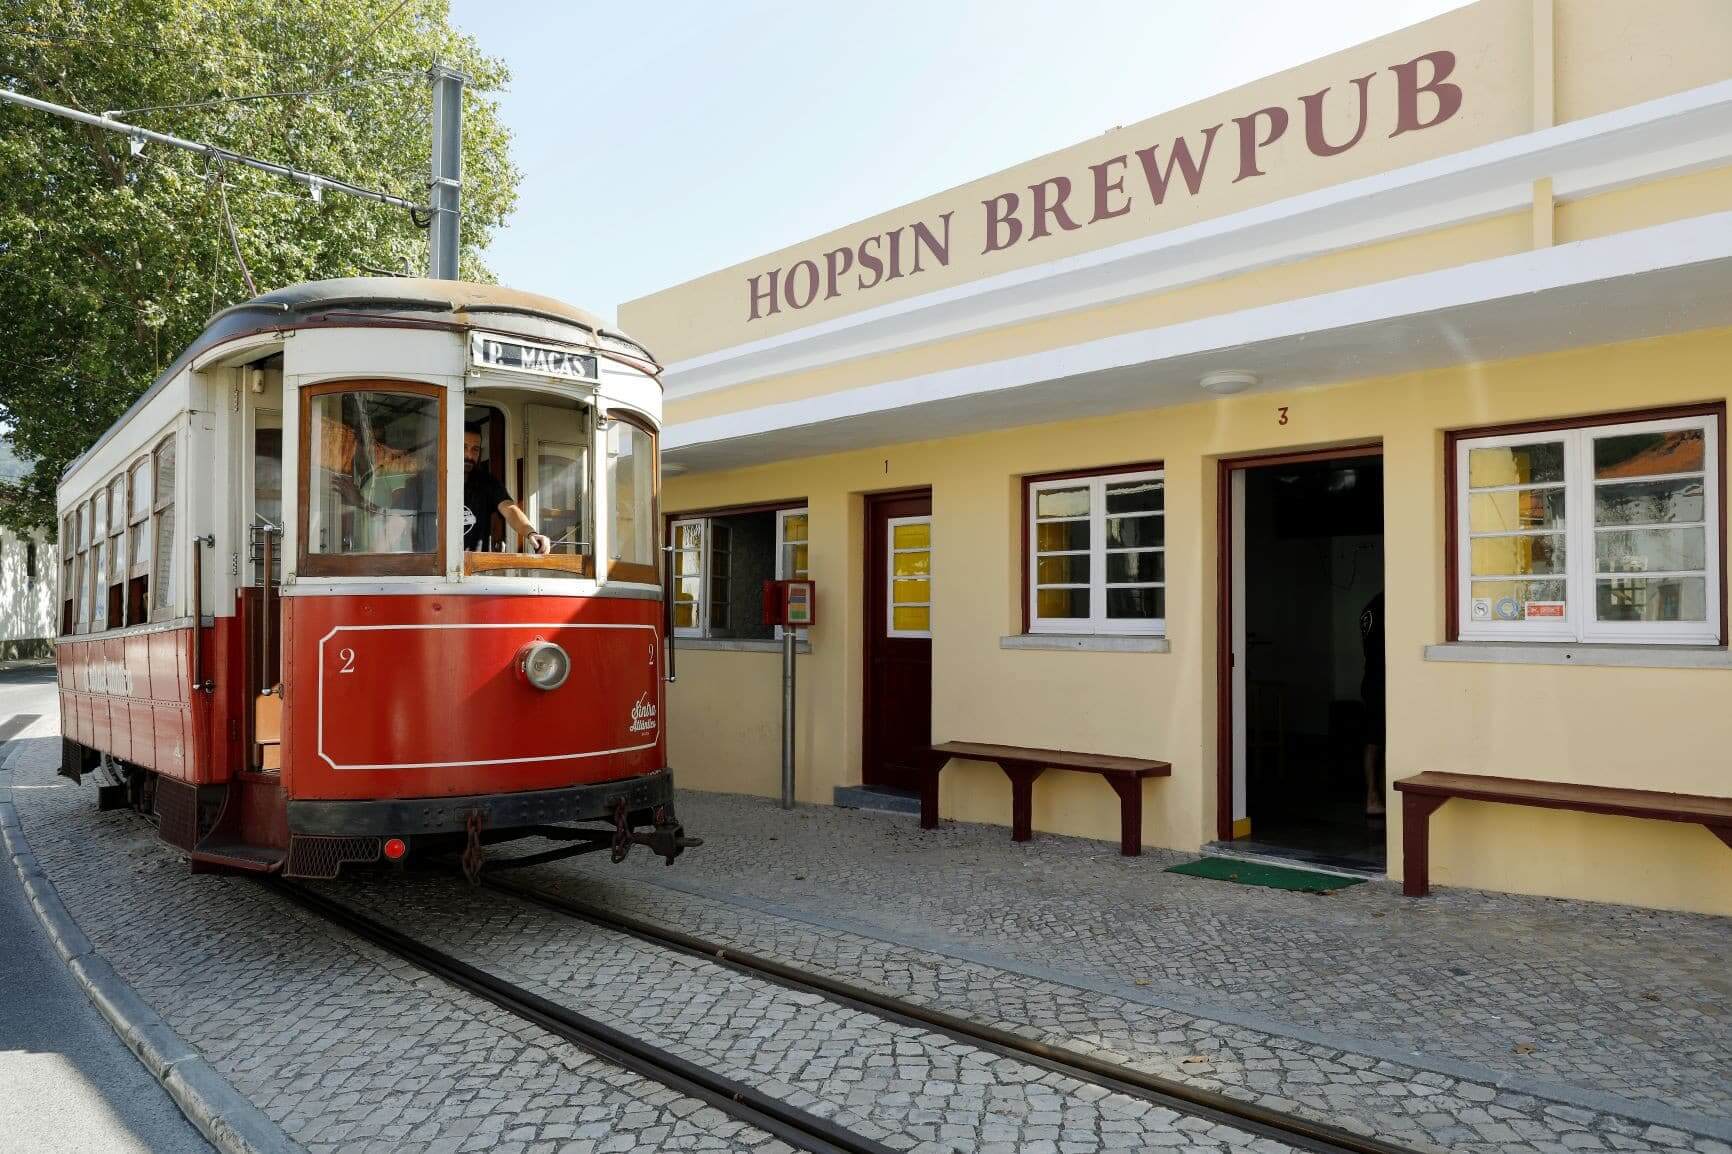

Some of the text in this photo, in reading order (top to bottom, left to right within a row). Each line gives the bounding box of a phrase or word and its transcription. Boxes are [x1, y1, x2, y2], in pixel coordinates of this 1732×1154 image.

[746, 50, 1463, 322] HOPSIN BREWPUB
[1277, 406, 1289, 426] 3
[884, 459, 888, 474] 1
[339, 647, 355, 673] 2
